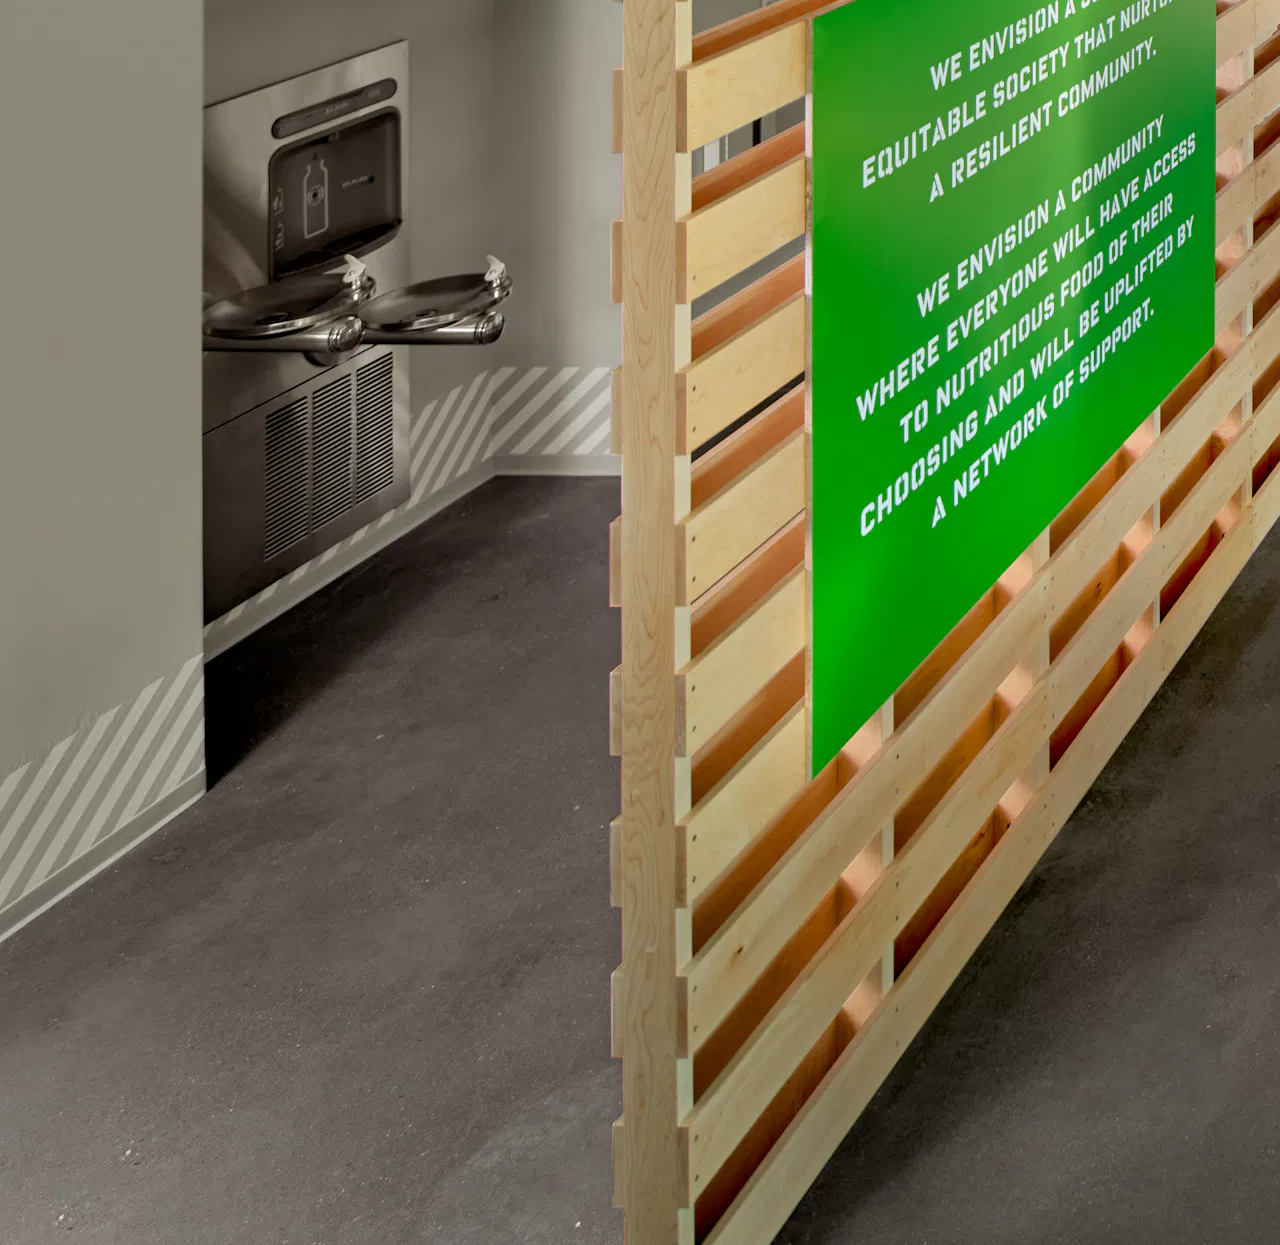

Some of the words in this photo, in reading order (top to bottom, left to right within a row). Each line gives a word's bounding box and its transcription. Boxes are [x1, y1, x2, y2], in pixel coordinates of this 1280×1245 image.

[862, 91, 986, 189] EQUITABLE
[992, 42, 1069, 110] SOCIETY
[1074, 15, 1116, 57] THAT
[930, 51, 962, 90] WE
[969, 2, 1059, 71] ENVISION
[930, 172, 944, 203] A
[951, 100, 1052, 189] RESILIENT
[1058, 36, 1157, 118] COMMUNITY.
[855, 335, 939, 421] WHERE
[946, 249, 1048, 350] EVERYONE
[1052, 217, 1095, 262] WILL
[1100, 177, 1139, 228] HAVE
[1143, 132, 1196, 194] ACCESS
[900, 400, 928, 444] TO
[936, 293, 1055, 415] NUTRITIOUS
[1060, 251, 1103, 307] FOOD
[1109, 233, 1127, 265] OF
[1132, 193, 1173, 243] THEIR
[917, 272, 950, 318] WE
[957, 200, 1049, 292] ENVISION
[1055, 189, 1066, 216] A
[1071, 114, 1165, 204] COMMUNITY
[860, 410, 978, 537] CHOOSING
[984, 371, 1025, 426] AND
[1030, 327, 1074, 381] WILL
[1079, 301, 1100, 336] BE
[1104, 234, 1173, 314] UPLIFTED
[1177, 215, 1194, 248] BY
[932, 497, 946, 528] A
[953, 395, 1048, 508] NETWORK
[1052, 372, 1074, 410] OF
[1079, 297, 1154, 383] SUPPORT.
